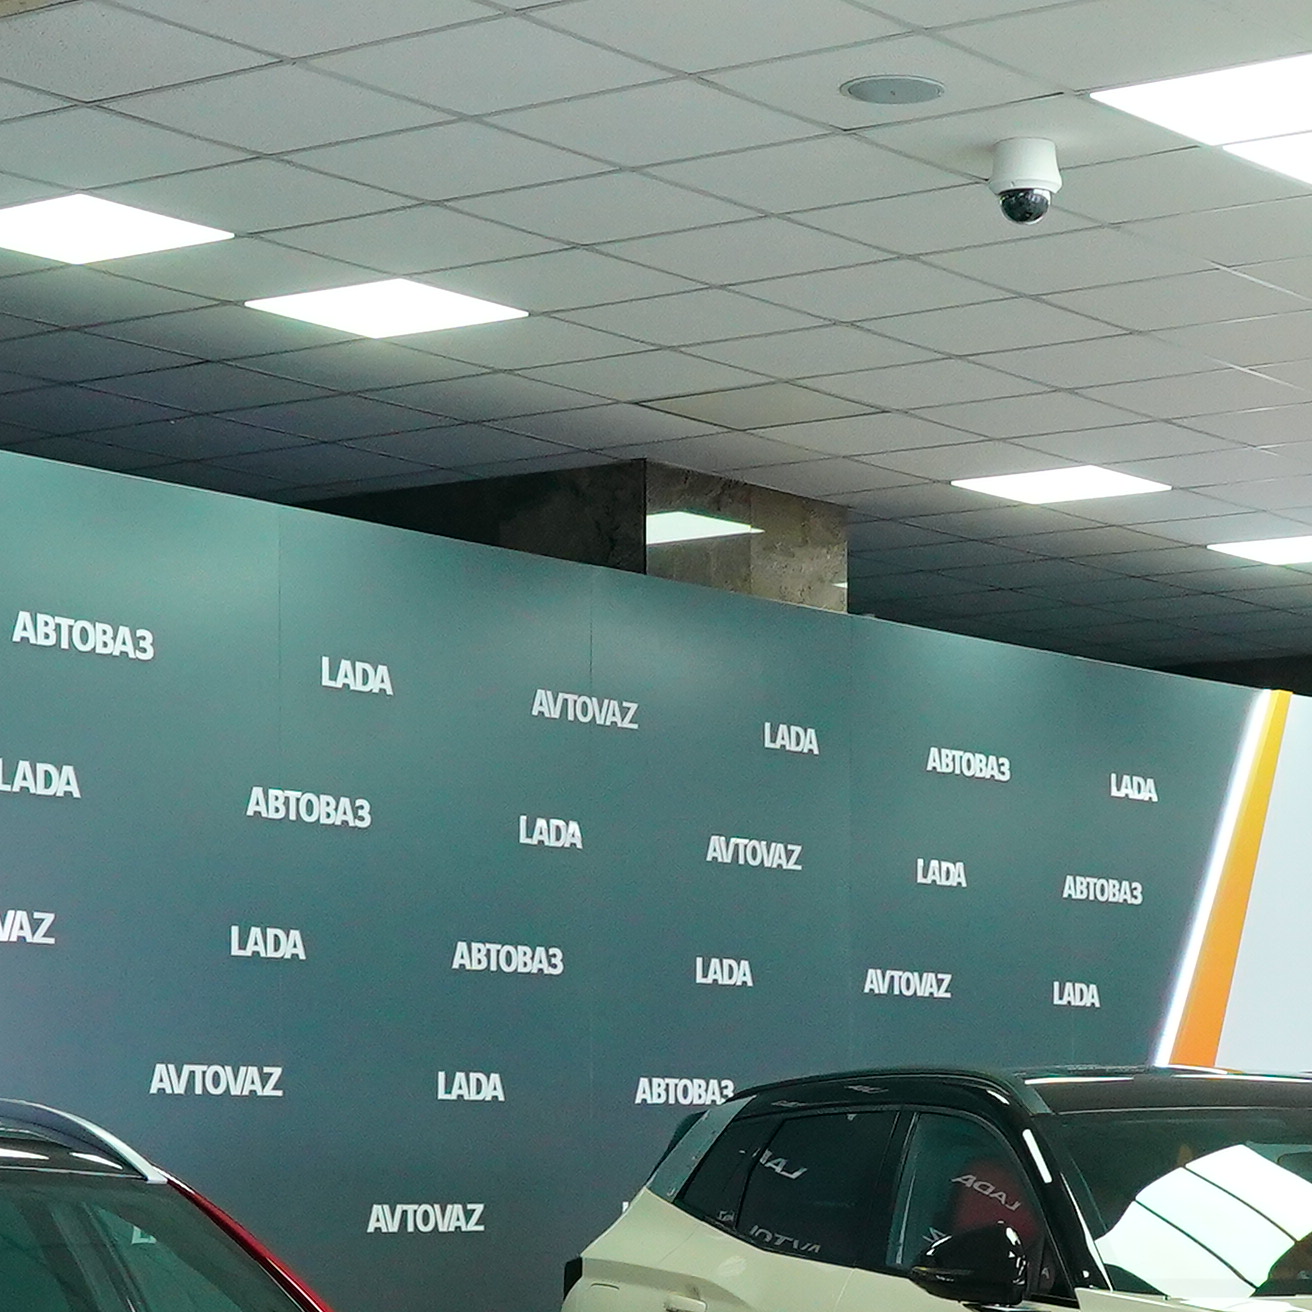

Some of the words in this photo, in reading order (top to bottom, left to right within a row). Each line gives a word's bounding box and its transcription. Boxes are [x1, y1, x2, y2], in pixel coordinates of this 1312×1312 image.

[12, 611, 154, 660] АВТОВАЗ
[321, 656, 393, 695] LADA
[531, 689, 639, 730] AVTOVAZ
[764, 722, 819, 755] LADA
[926, 747, 1011, 782] АВТОВАЗ
[1110, 774, 1158, 802] LADA
[246, 787, 372, 828] АВТОВАЗ
[519, 815, 583, 849] LADA
[706, 836, 802, 871] AVTOVAZ
[916, 858, 967, 888] LADA
[1062, 875, 1143, 905] АВТОВАЗ
[230, 926, 306, 960] LADA
[451, 942, 564, 975] АВТОВАЗ
[696, 957, 753, 987] LADA
[863, 968, 952, 998] AVTOVAZ
[1053, 982, 1100, 1008] LADA
[149, 1064, 283, 1097] AVTOVAZ
[437, 1071, 505, 1102] LADA
[634, 1077, 735, 1105] АВТОВАЗ
[366, 1203, 485, 1233] AVTOVAZ
